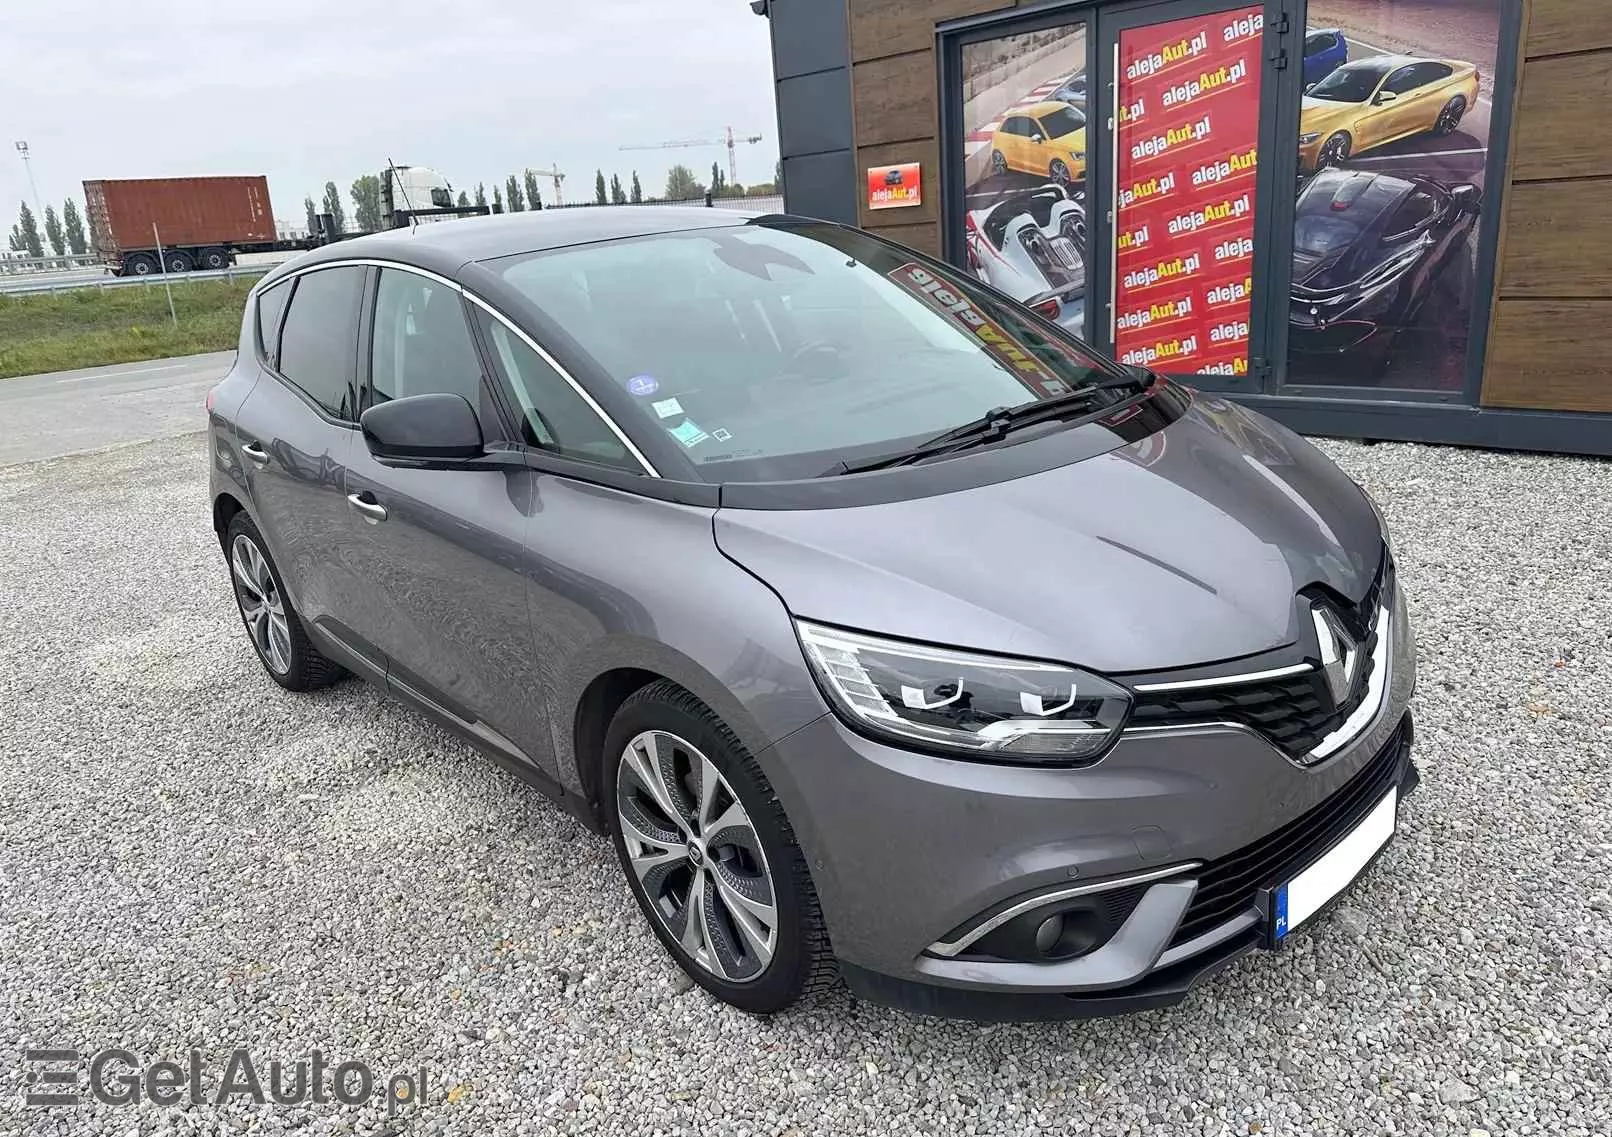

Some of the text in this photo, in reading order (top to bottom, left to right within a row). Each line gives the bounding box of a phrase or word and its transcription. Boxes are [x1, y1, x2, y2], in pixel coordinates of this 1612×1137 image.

[1223, 14, 1263, 41] aleja
[1126, 31, 1207, 80] alejaAut.pl
[1162, 59, 1246, 106] alejaAut.pl
[1131, 116, 1211, 160] alejaAut.pl
[1168, 195, 1250, 233] alejaAut.pl
[1214, 237, 1253, 260] aleja
[1123, 253, 1200, 288] alejaAut.pl
[1117, 296, 1192, 329] alejaAut.pl
[1210, 321, 1249, 341] aleja
[1122, 335, 1197, 364] alejaAut.pl
[1276, 916, 1287, 930] PL
